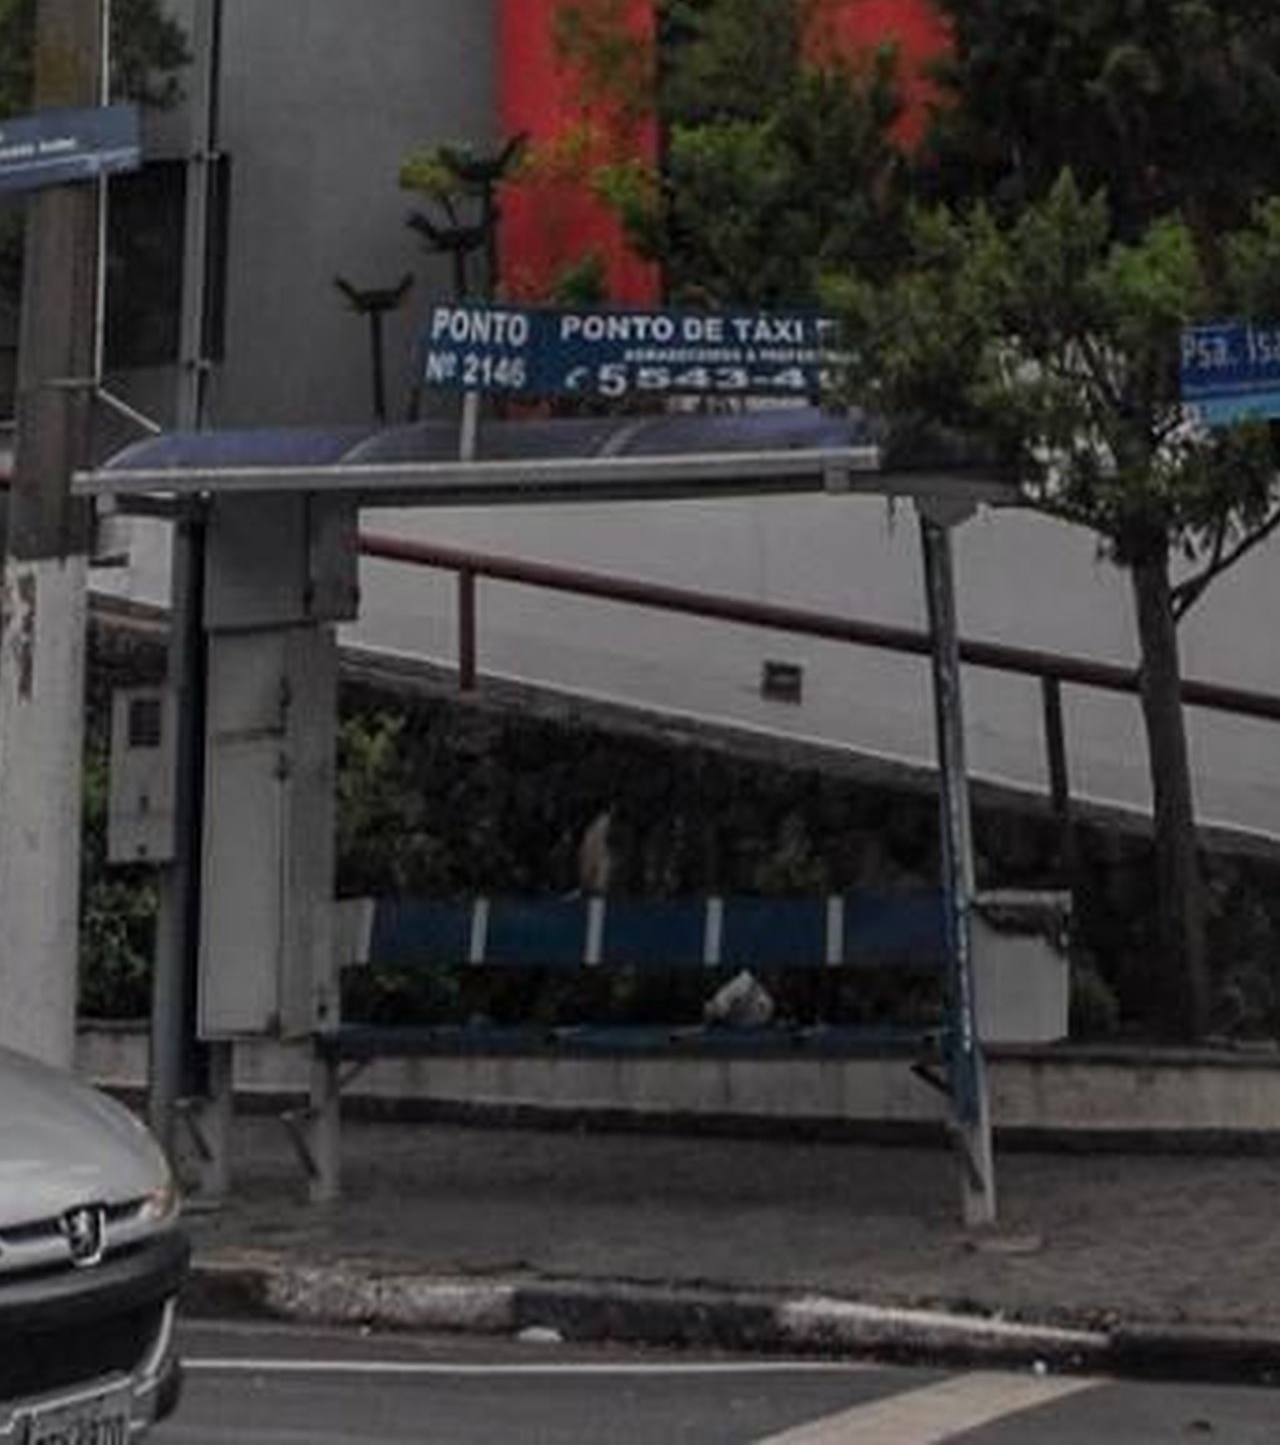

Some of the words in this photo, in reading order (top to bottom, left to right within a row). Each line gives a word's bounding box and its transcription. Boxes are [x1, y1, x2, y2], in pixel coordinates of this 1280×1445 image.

[430, 308, 529, 347] PONTO
[560, 316, 674, 342] PONTO
[683, 318, 722, 342] DE
